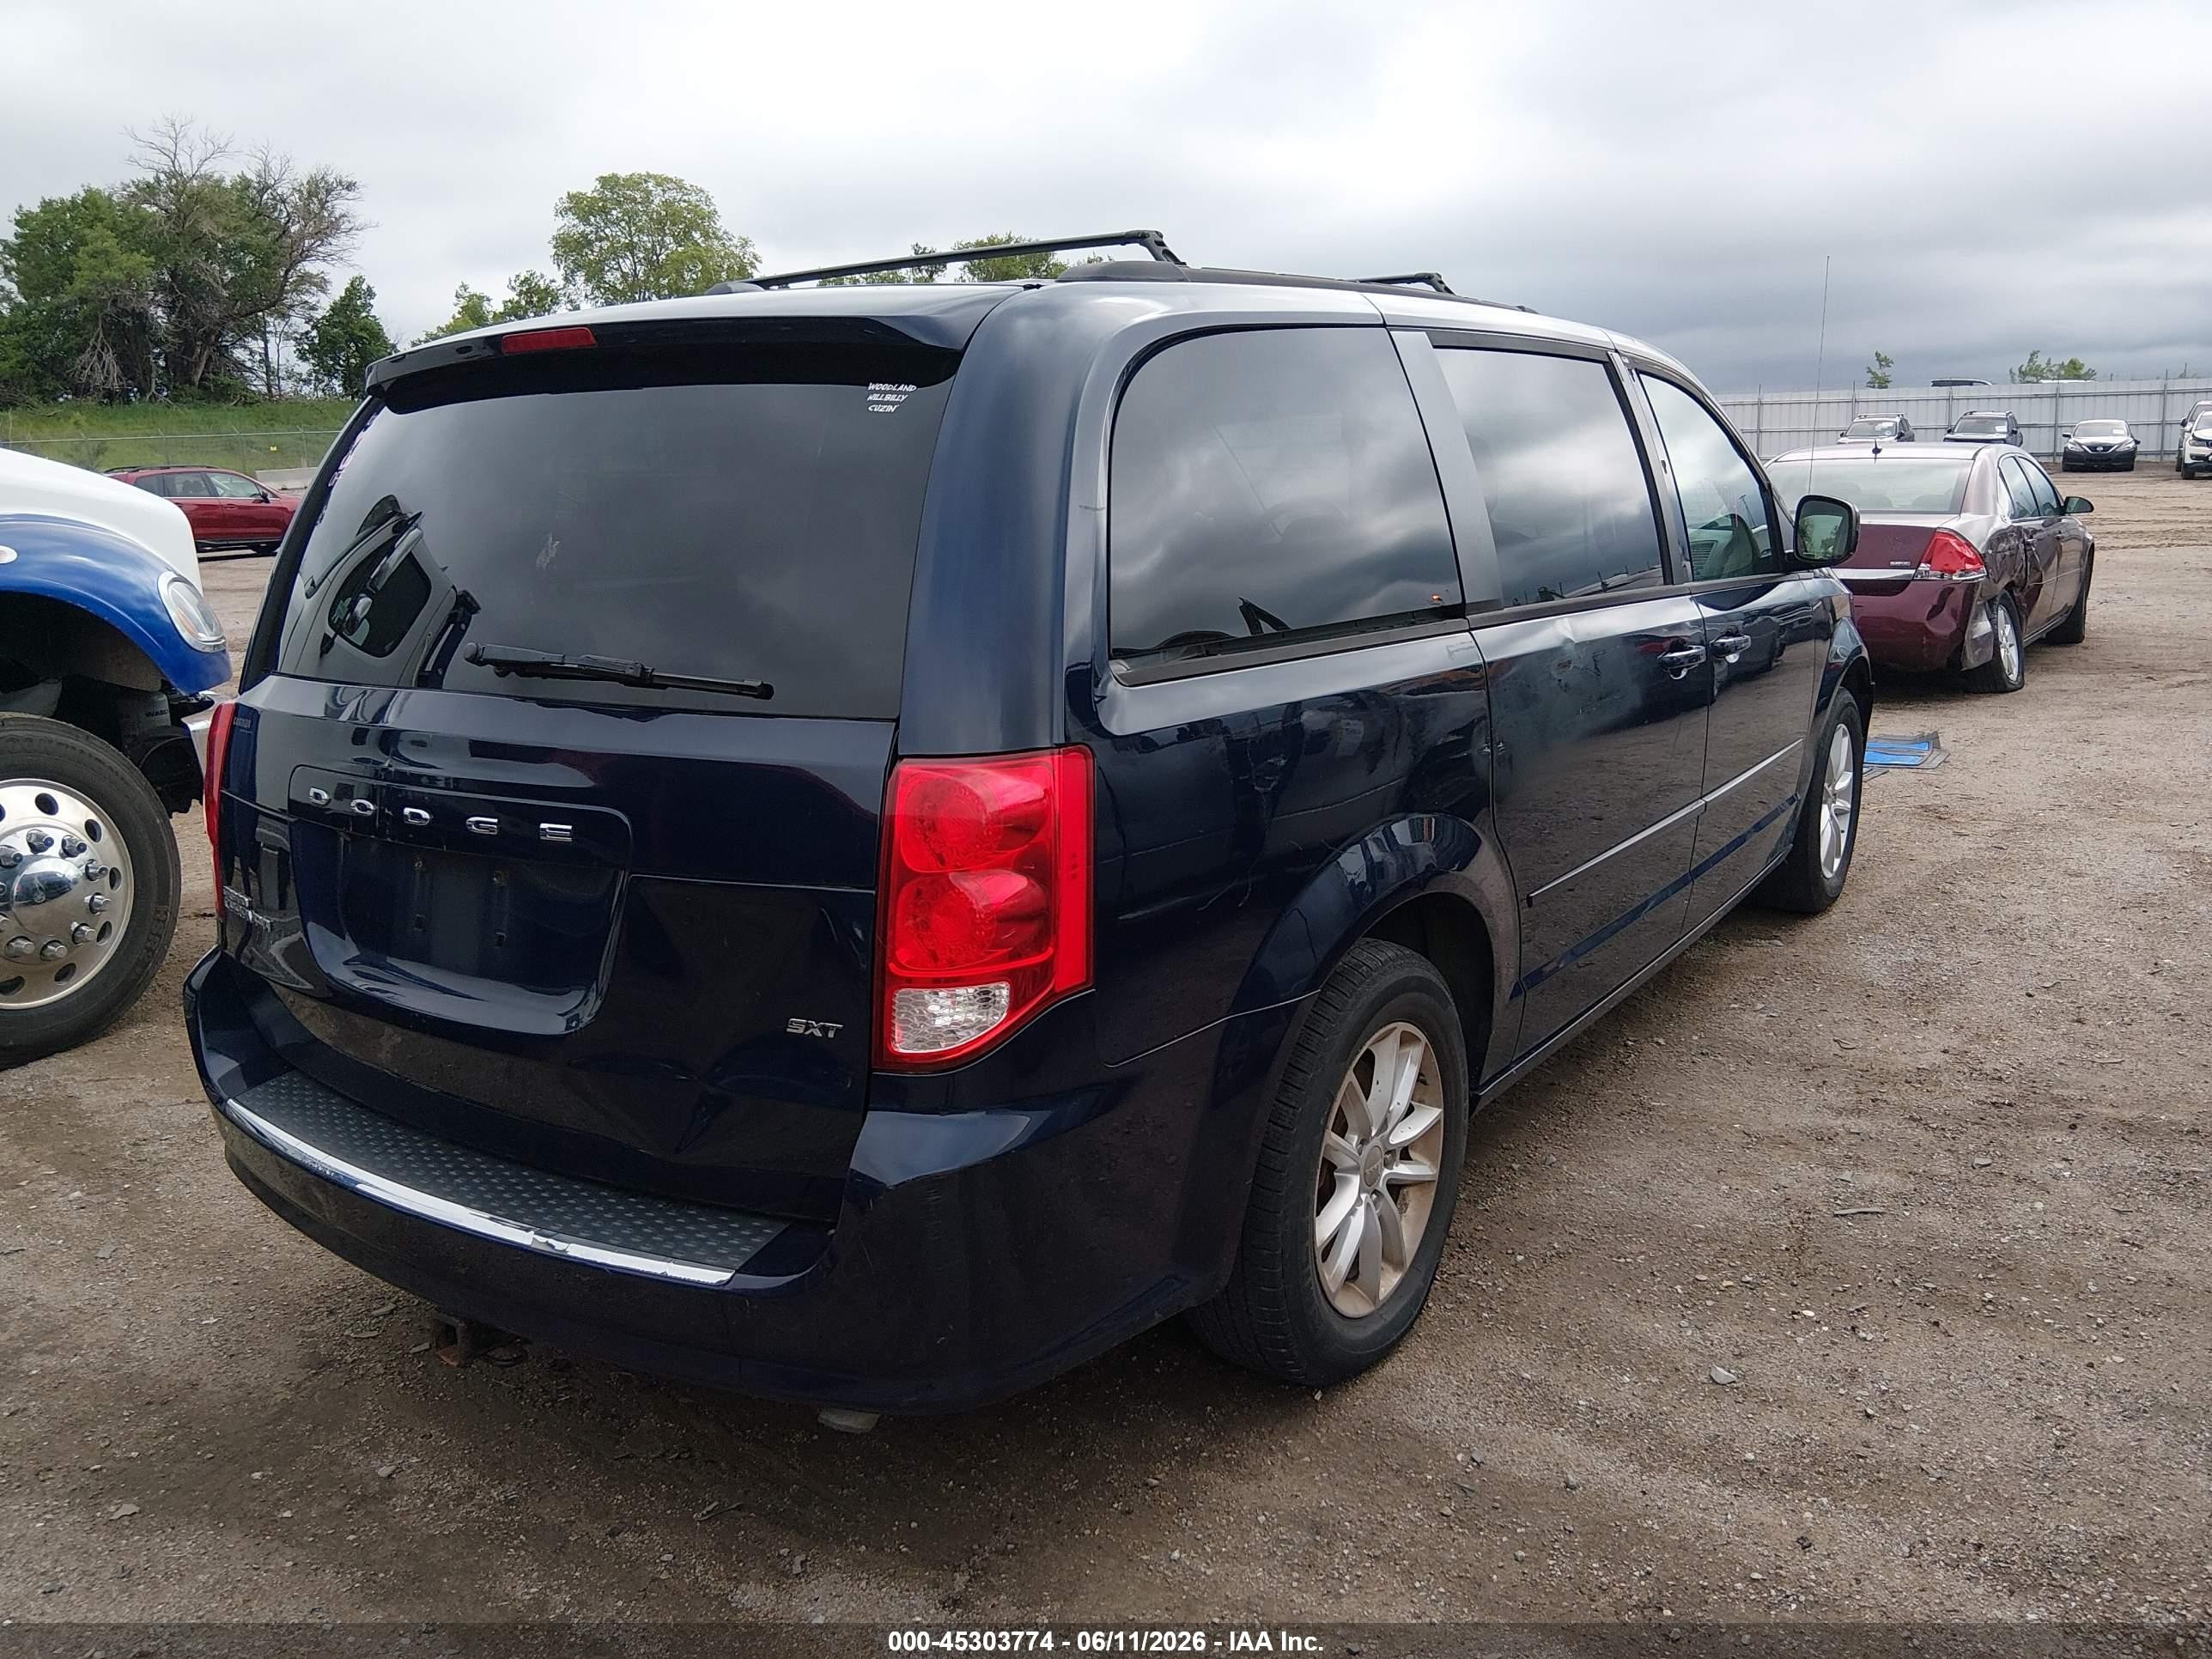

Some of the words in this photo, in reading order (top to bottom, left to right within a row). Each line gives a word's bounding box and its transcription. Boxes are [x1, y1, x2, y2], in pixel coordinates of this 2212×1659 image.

[867, 382, 917, 392] WOODLAND
[866, 393, 908, 403] HILLBILLY
[309, 787, 574, 842] DODGE
[786, 1018, 844, 1038] SXT
